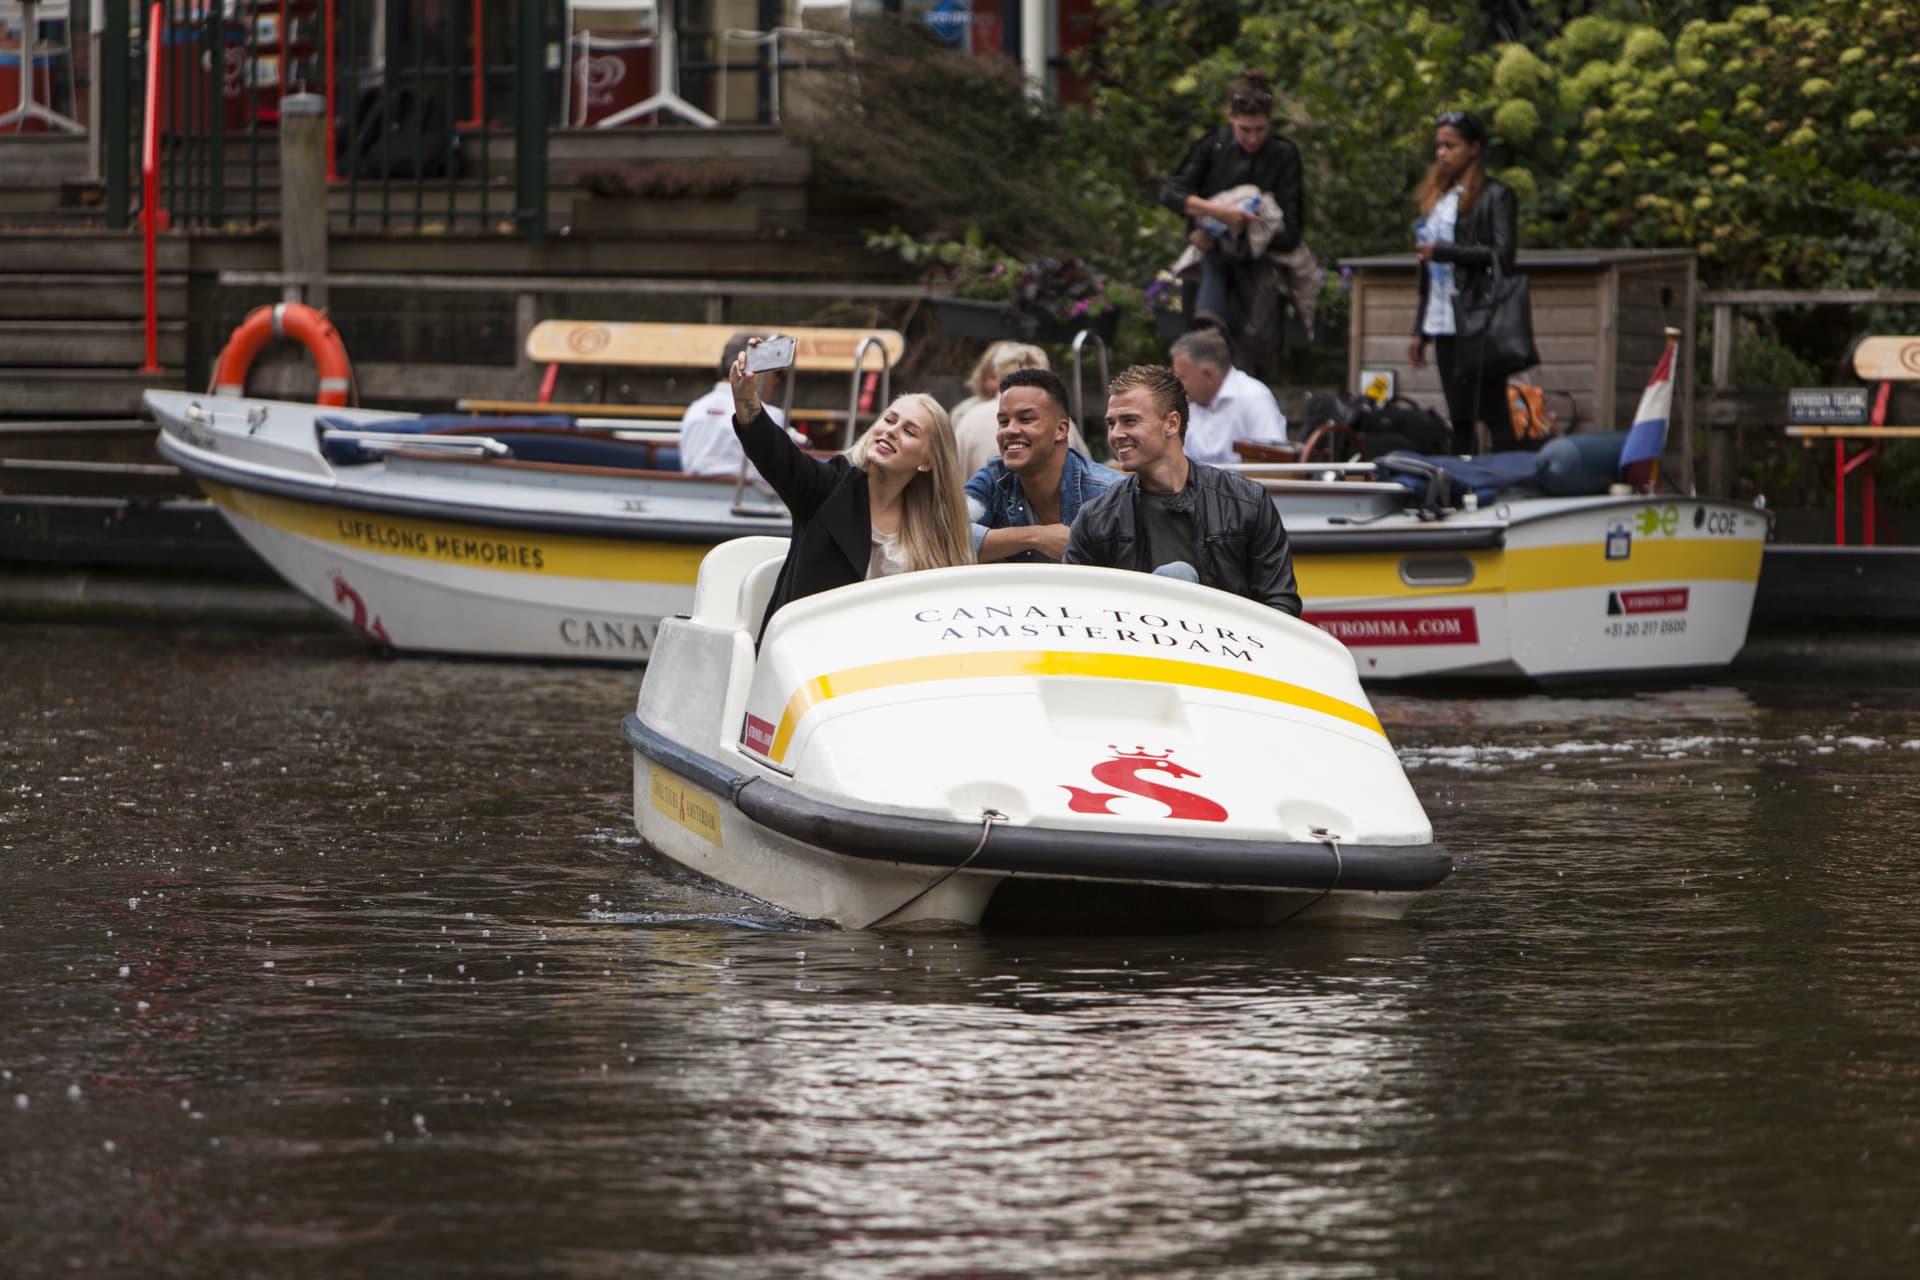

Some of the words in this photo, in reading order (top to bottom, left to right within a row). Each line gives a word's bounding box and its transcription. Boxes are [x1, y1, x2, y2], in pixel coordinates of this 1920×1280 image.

[1708, 512, 1738, 535] COE
[338, 517, 428, 553] LIFELONG
[435, 535, 544, 569] MEMORIES
[915, 605, 1083, 623] CANAL
[1103, 608, 1265, 650] TOURS
[940, 624, 1254, 663] AMSTERDAM
[1319, 618, 1462, 638] STROMMA.COM
[1604, 622, 1622, 638] +31
[1625, 621, 1640, 637] 20
[1641, 620, 1659, 636] 217
[686, 800, 717, 832] AMSTERDAM
